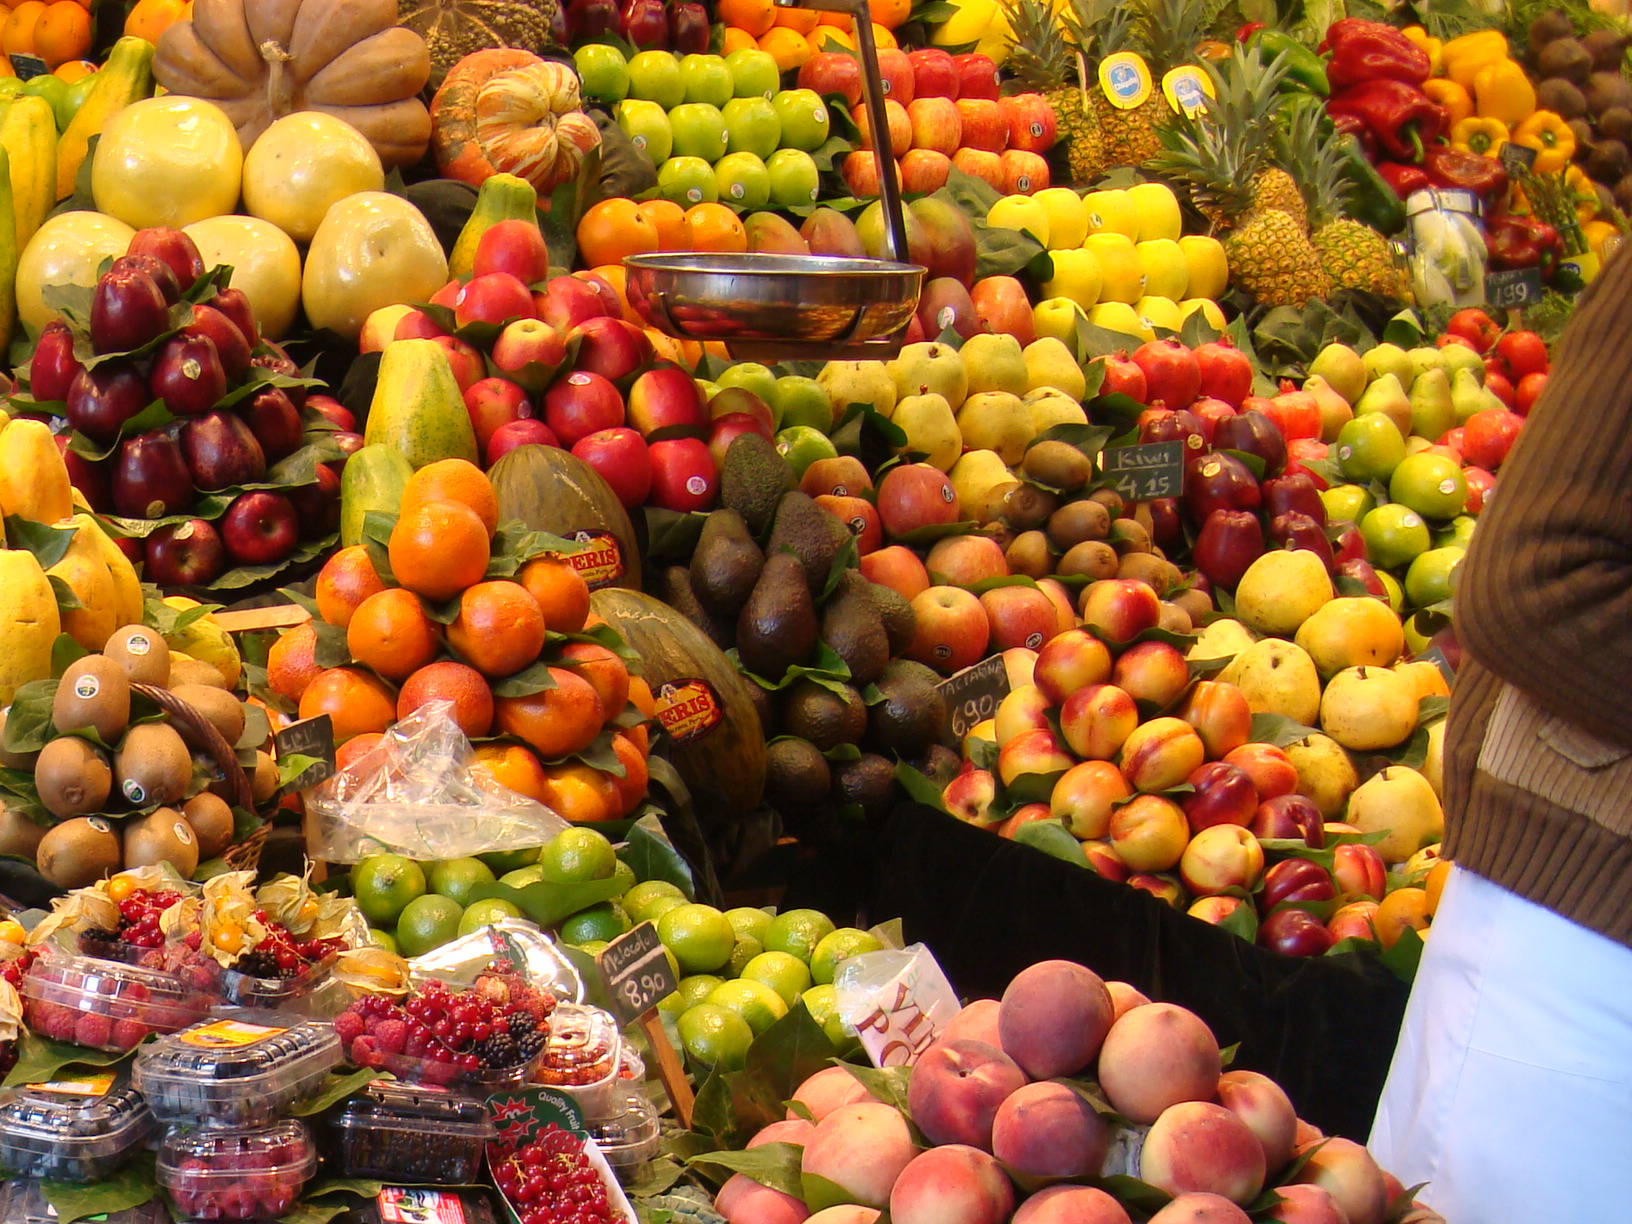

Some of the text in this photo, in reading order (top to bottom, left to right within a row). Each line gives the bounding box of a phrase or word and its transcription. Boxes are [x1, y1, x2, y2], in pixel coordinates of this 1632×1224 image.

[1118, 447, 1170, 469] Kiwi
[563, 549, 617, 571] ERIS
[656, 694, 711, 726] ERIS
[538, 1091, 581, 1130] Quality Fruit
